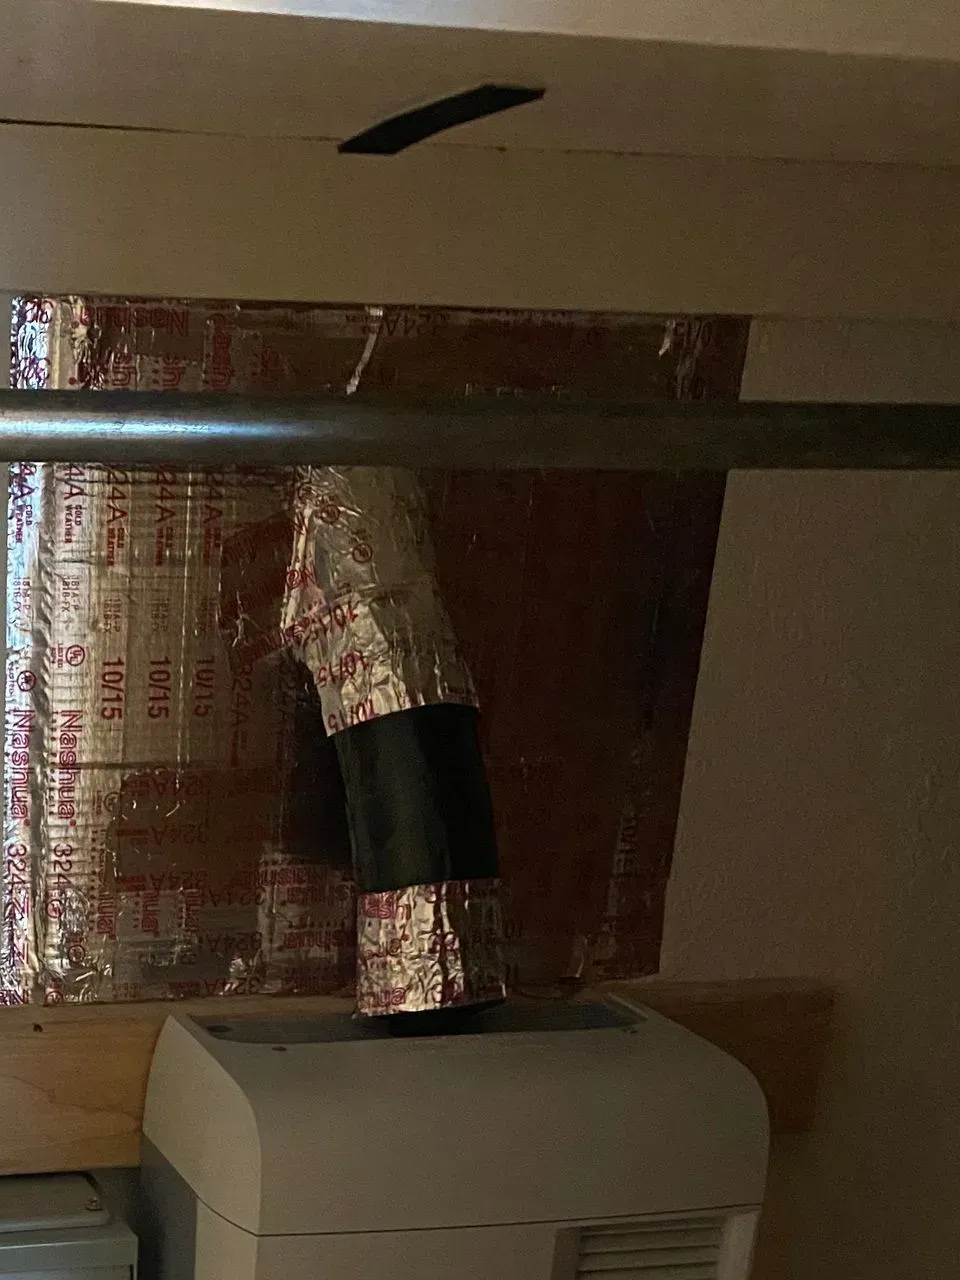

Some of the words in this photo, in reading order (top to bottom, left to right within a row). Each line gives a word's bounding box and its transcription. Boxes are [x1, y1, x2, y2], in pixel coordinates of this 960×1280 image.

[63, 463, 85, 500] 4A
[105, 466, 128, 526] 24A
[155, 466, 177, 526] 24A
[65, 504, 73, 544] WEATHER
[101, 657, 126, 721] 10/15
[148, 655, 172, 720] 10/15
[194, 654, 216, 718] 10/15
[11, 709, 37, 820] Nashua
[57, 709, 84, 819] Nashua
